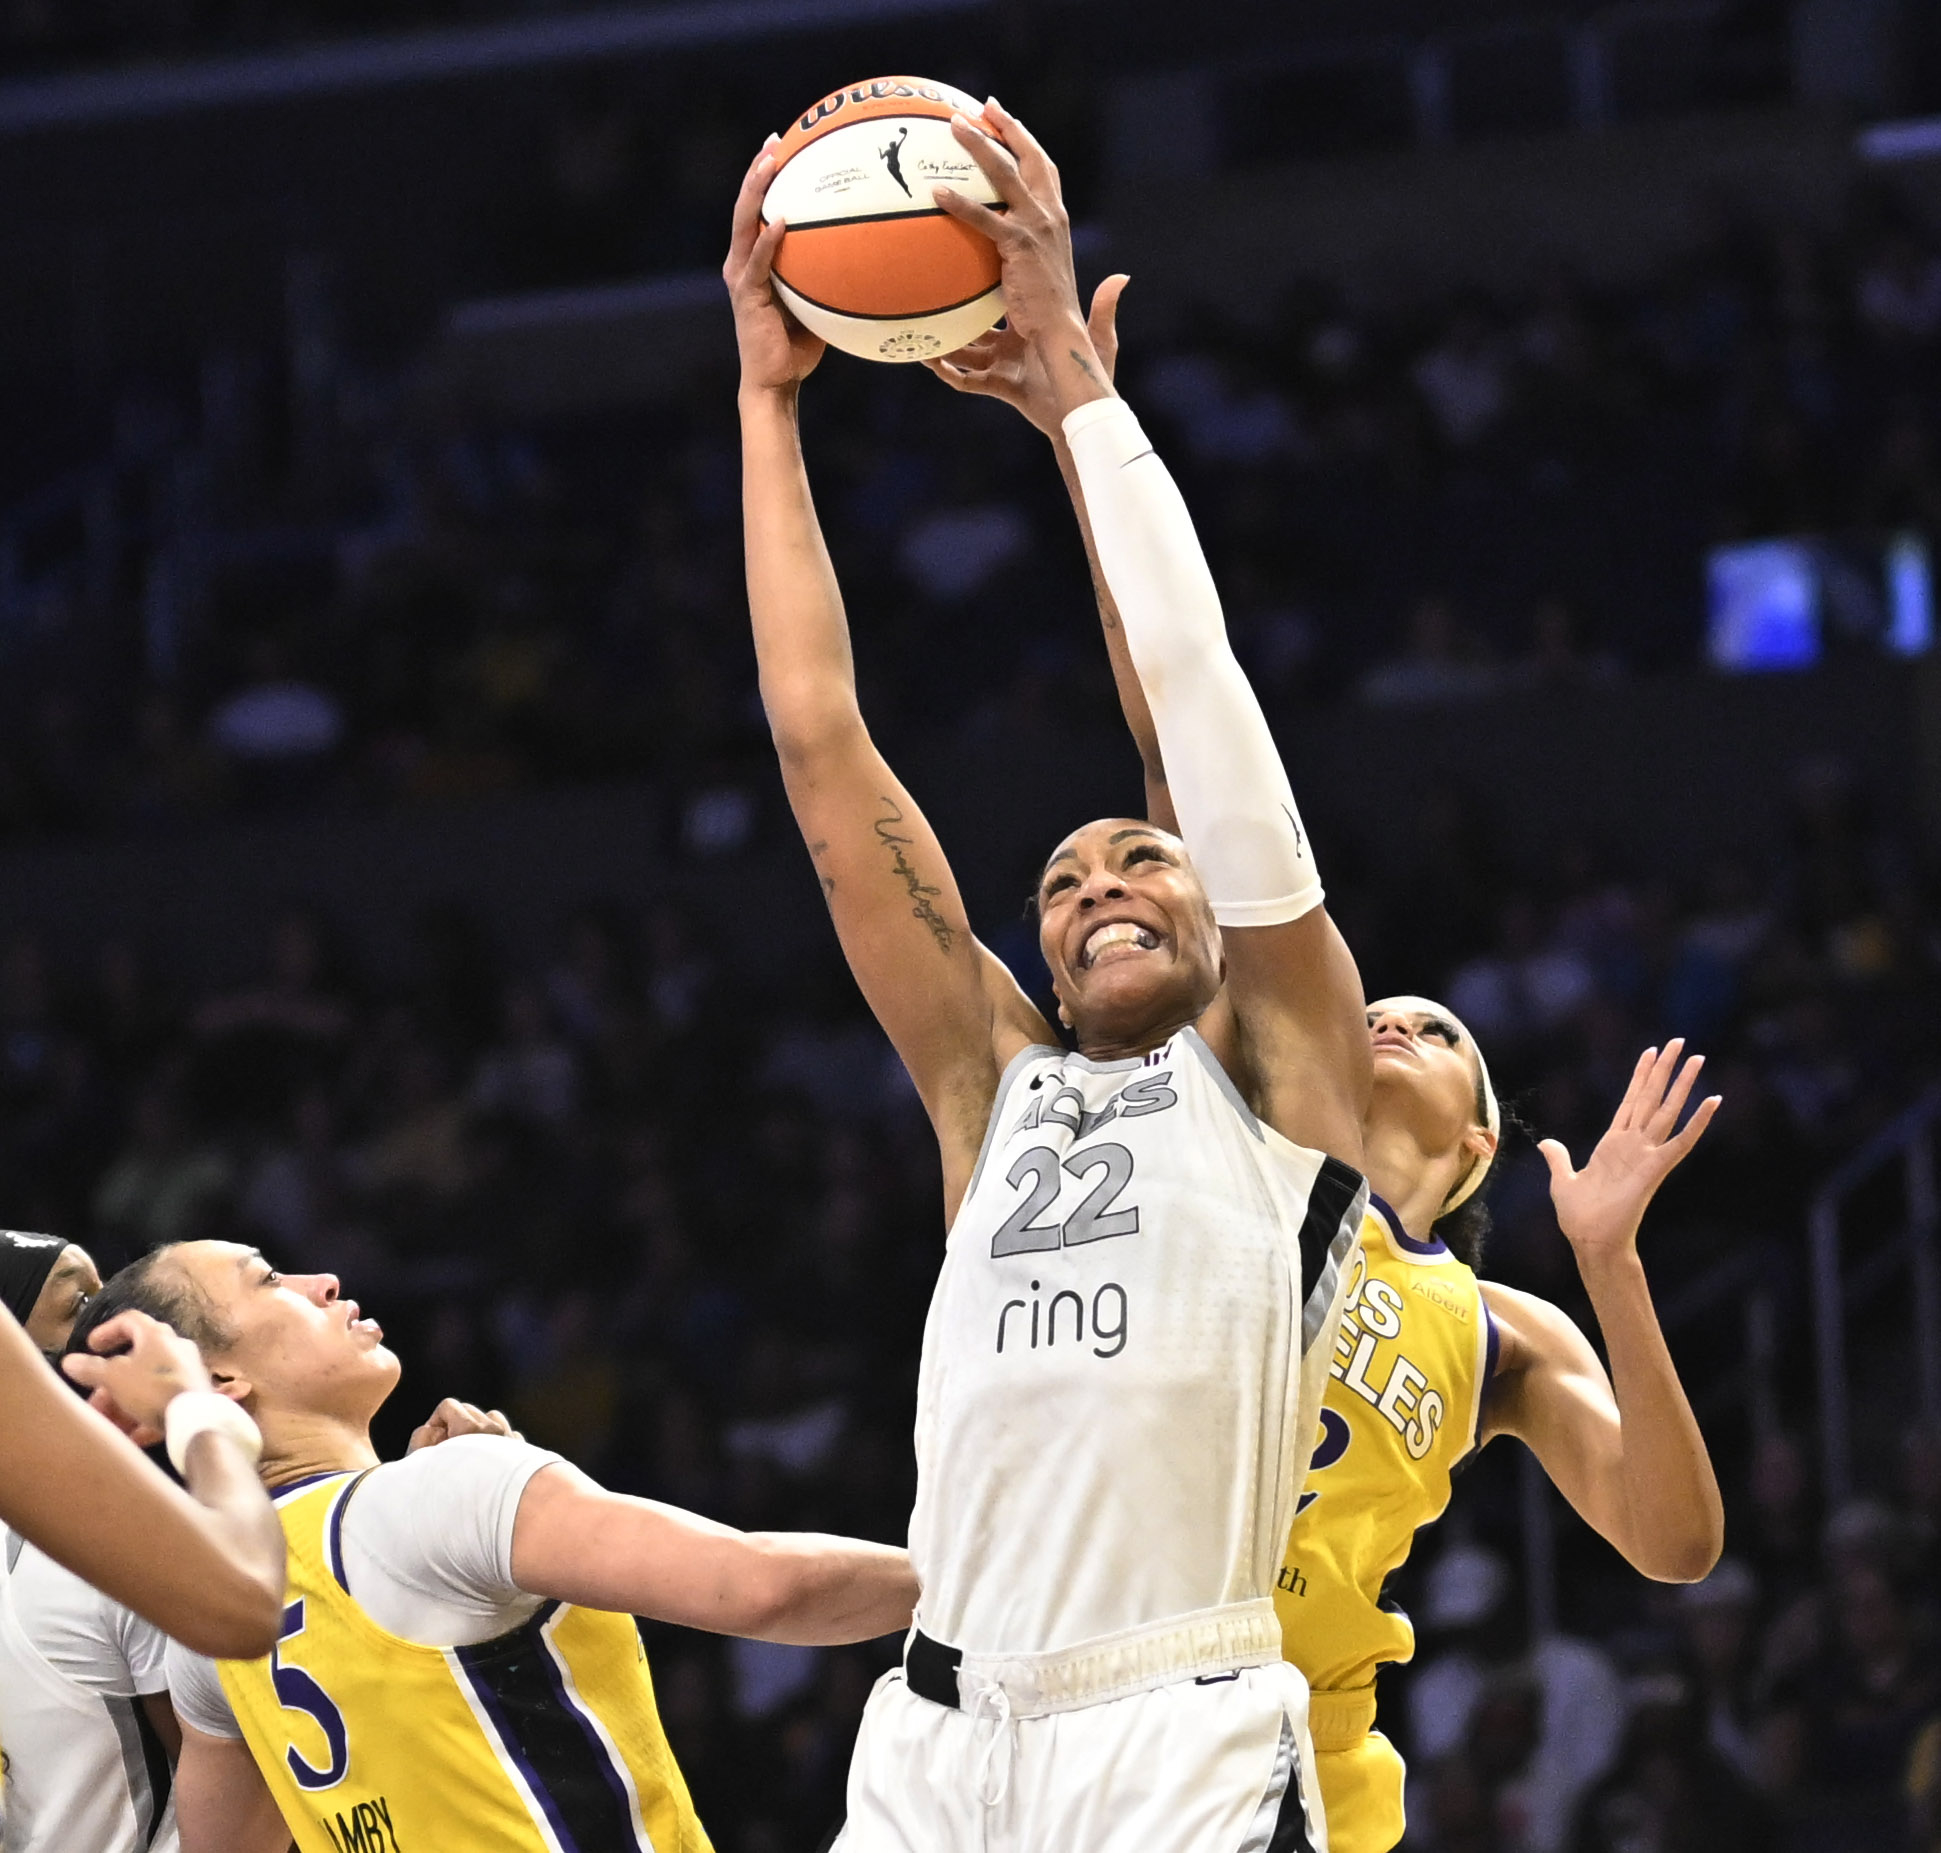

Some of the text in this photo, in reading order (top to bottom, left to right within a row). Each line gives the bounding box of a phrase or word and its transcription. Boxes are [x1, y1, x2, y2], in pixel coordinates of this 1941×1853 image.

[800, 80, 972, 131] Wilso
[991, 1142, 1139, 1258] 22
[996, 1280, 1128, 1358] ring
[1411, 1282, 1469, 1319] Albert
[271, 1595, 349, 1792] 5
